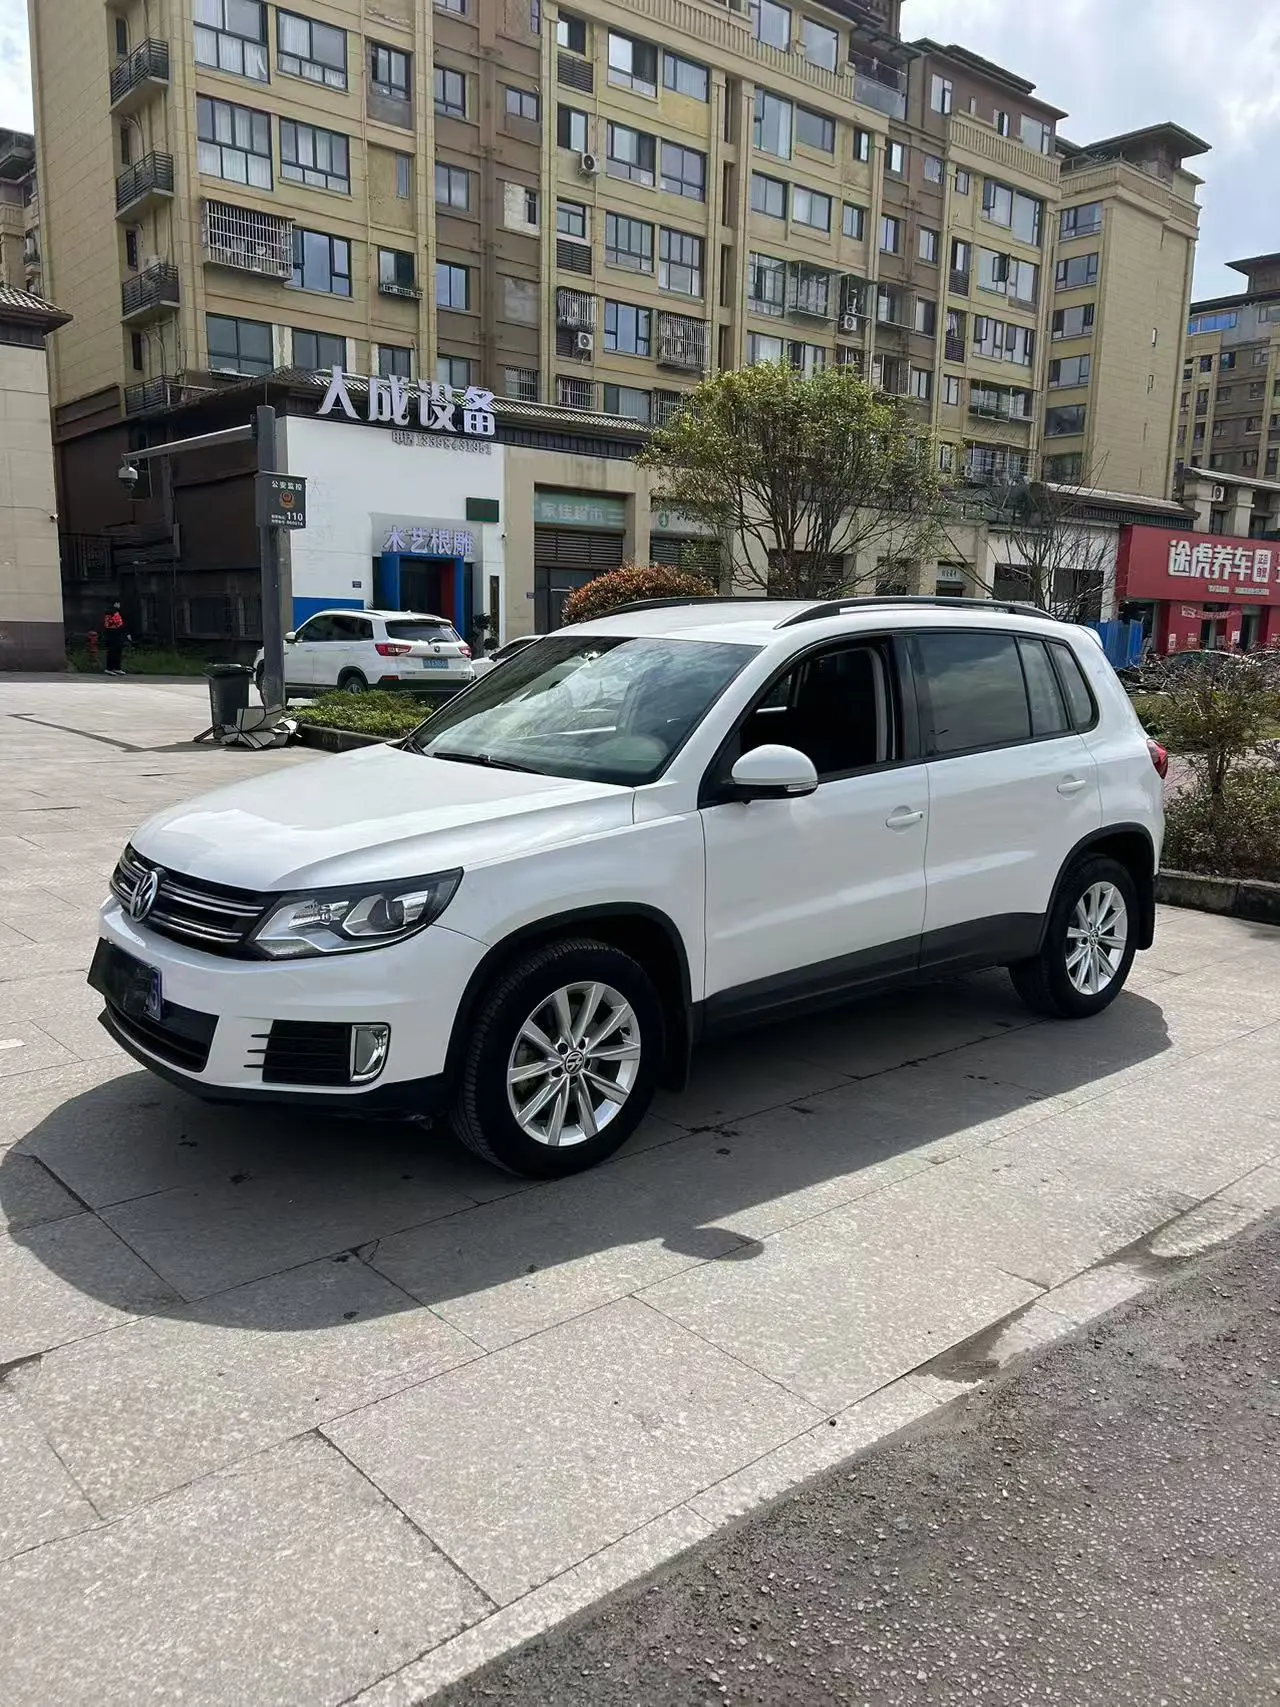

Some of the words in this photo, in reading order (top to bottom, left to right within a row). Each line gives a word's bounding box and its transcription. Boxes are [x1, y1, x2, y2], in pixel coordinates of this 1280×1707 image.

[271, 480, 302, 491] 公安监控
[286, 511, 304, 522] 110
[383, 524, 474, 556] 木艺根雕
[1167, 539, 1254, 581] 途虎养车
